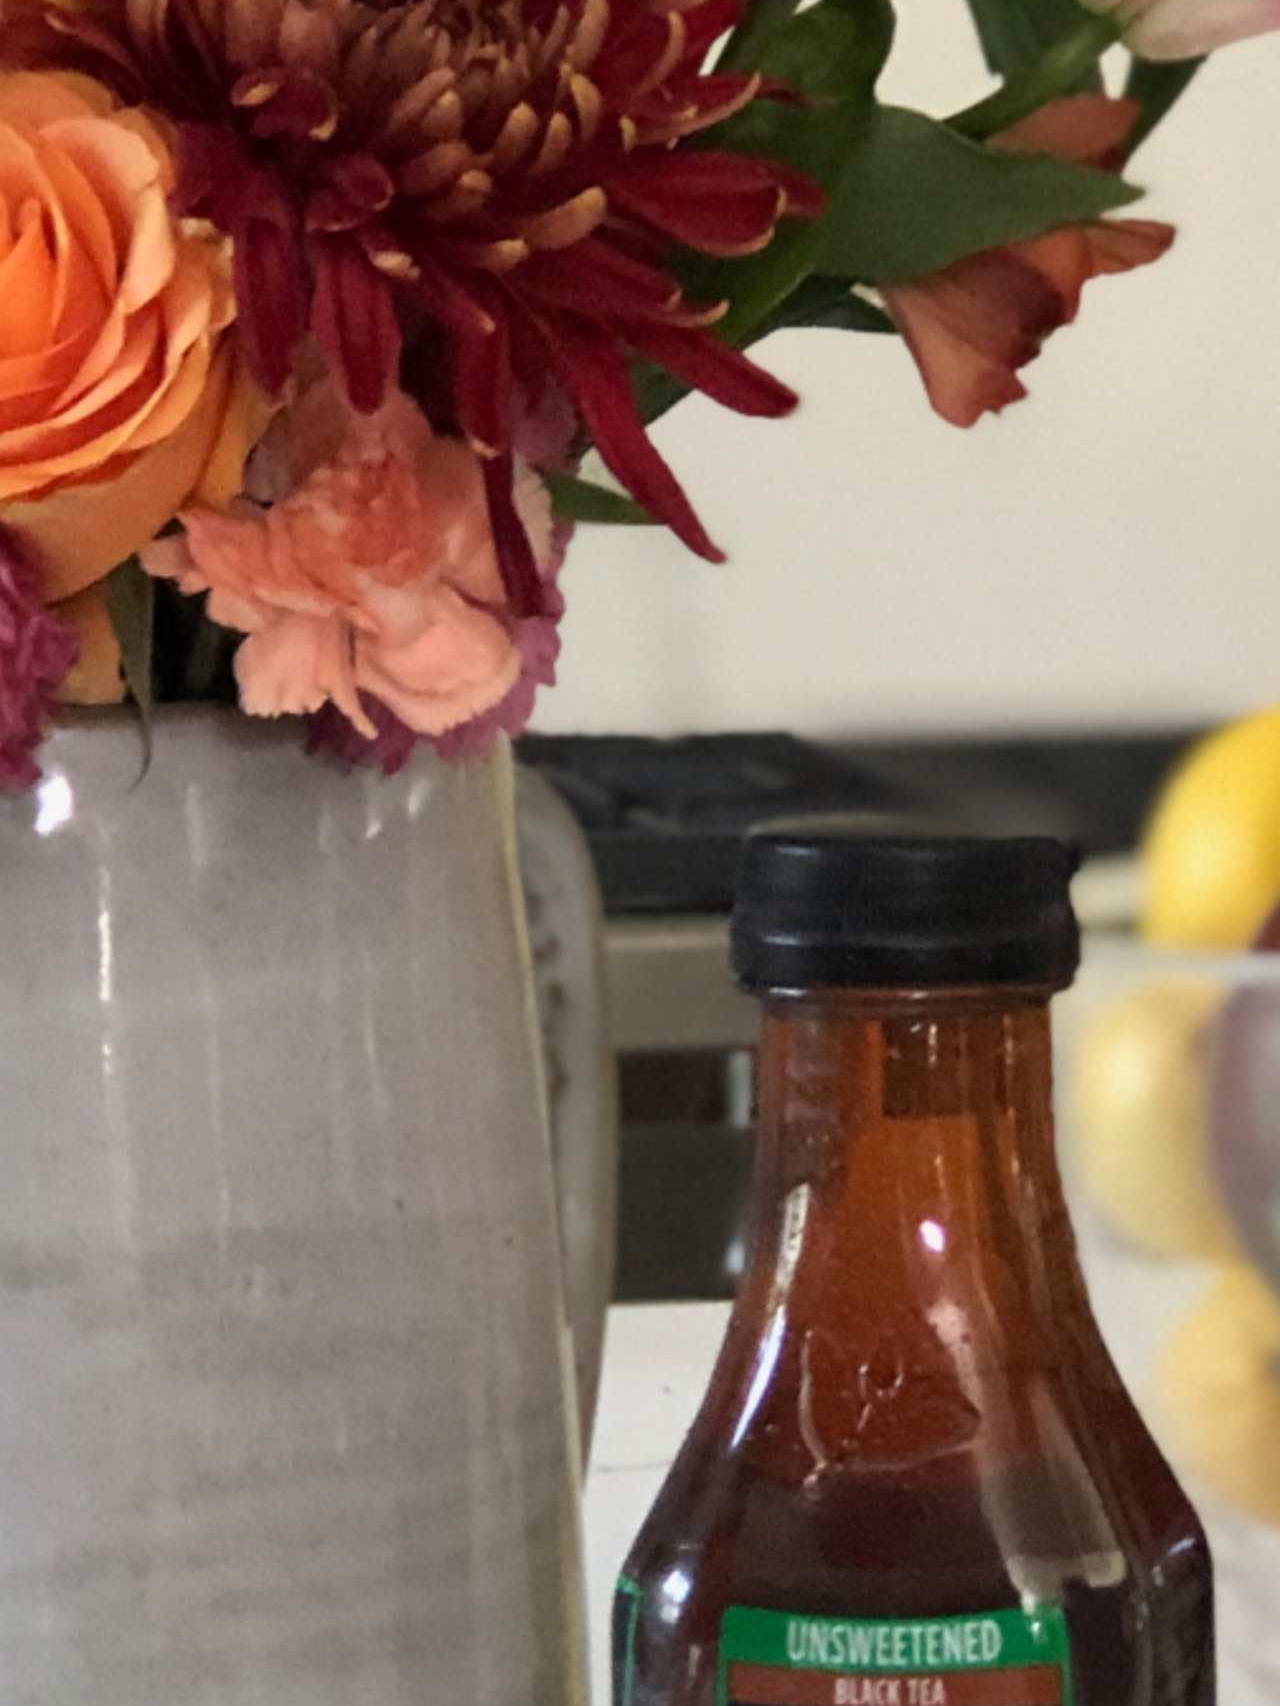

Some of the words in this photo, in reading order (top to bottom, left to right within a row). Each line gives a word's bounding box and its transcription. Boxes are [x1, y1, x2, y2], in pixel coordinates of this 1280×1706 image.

[786, 1621, 1004, 1664] UNSWEETENED
[833, 1677, 898, 1706] BLACK
[908, 1679, 946, 1706] TEA
